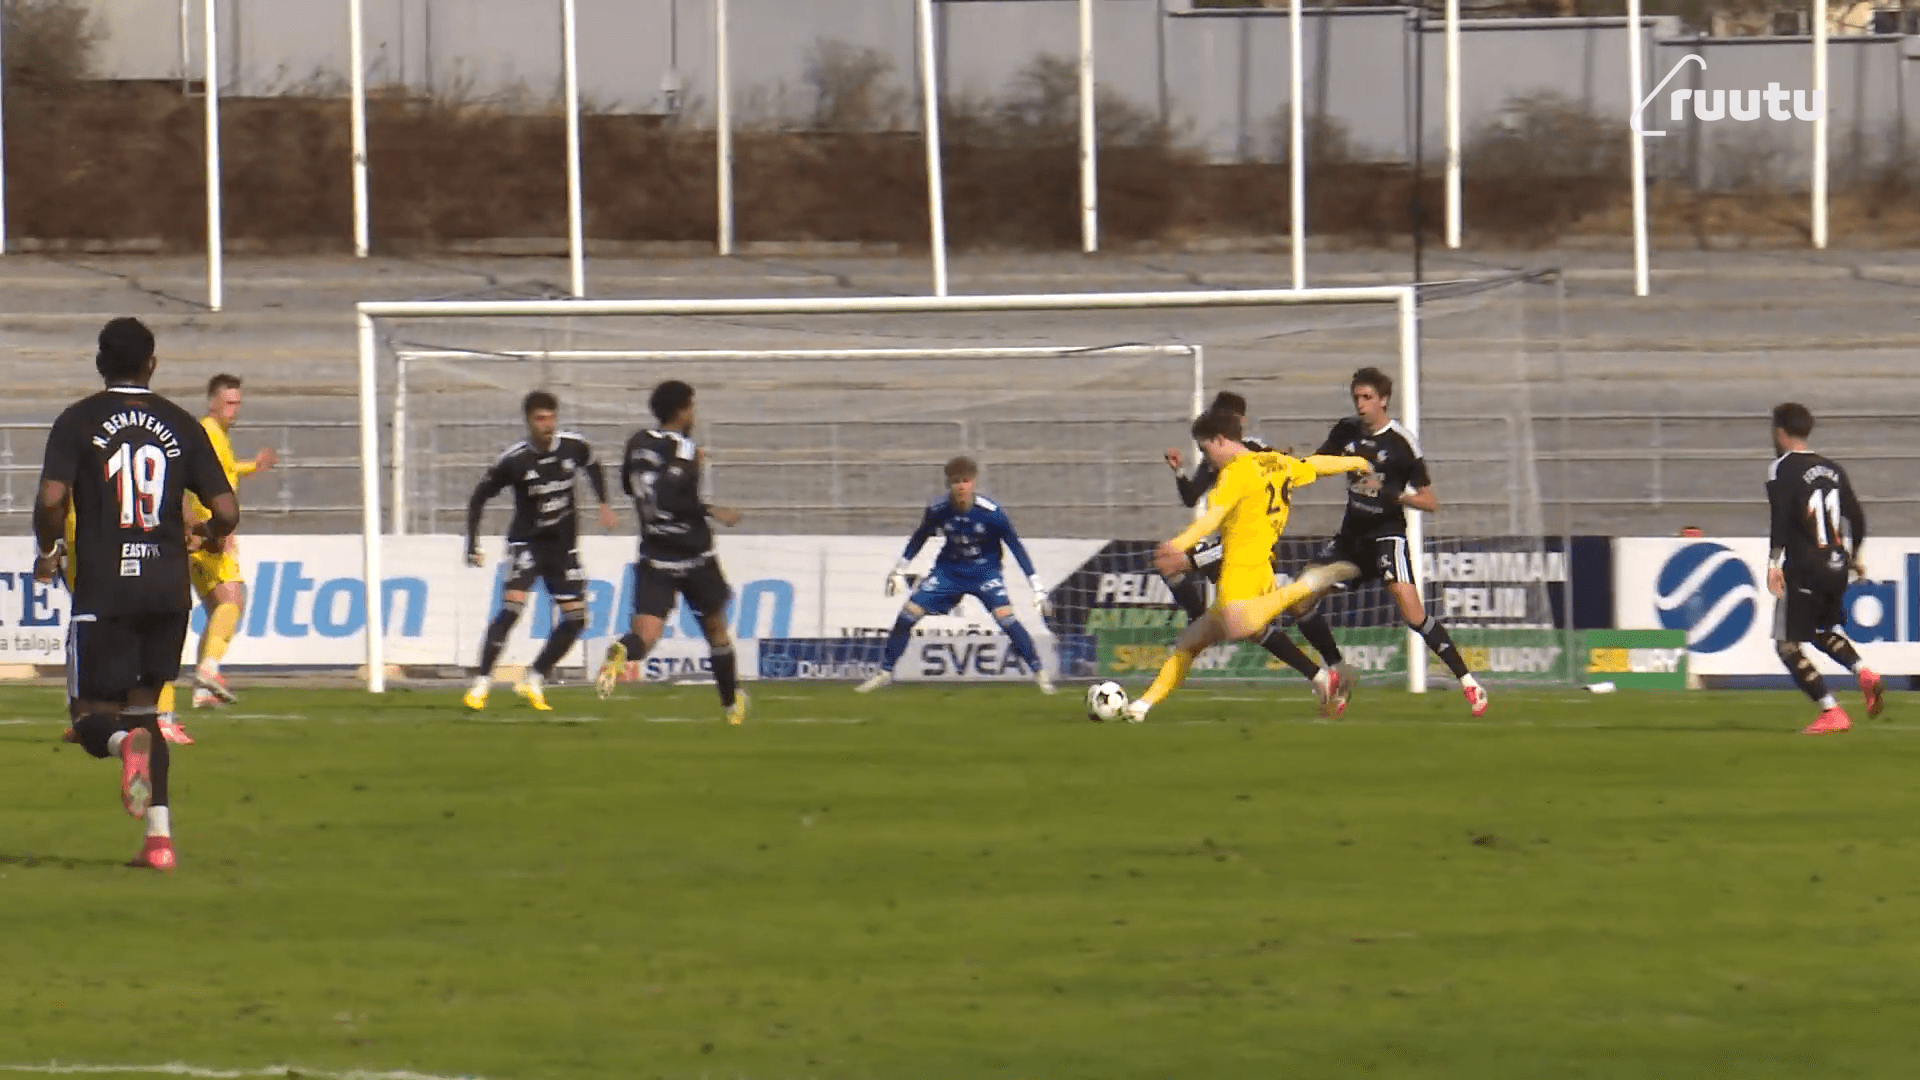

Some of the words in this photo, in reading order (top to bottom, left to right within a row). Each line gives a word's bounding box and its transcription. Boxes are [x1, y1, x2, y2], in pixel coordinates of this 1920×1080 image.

[102, 410, 181, 458] BENAVENUTO
[104, 442, 167, 530] 19
[1808, 488, 1841, 547] 11
[0, 572, 60, 626] E
[1443, 588, 1527, 618] PELIN
[921, 643, 1026, 676] SVEA
